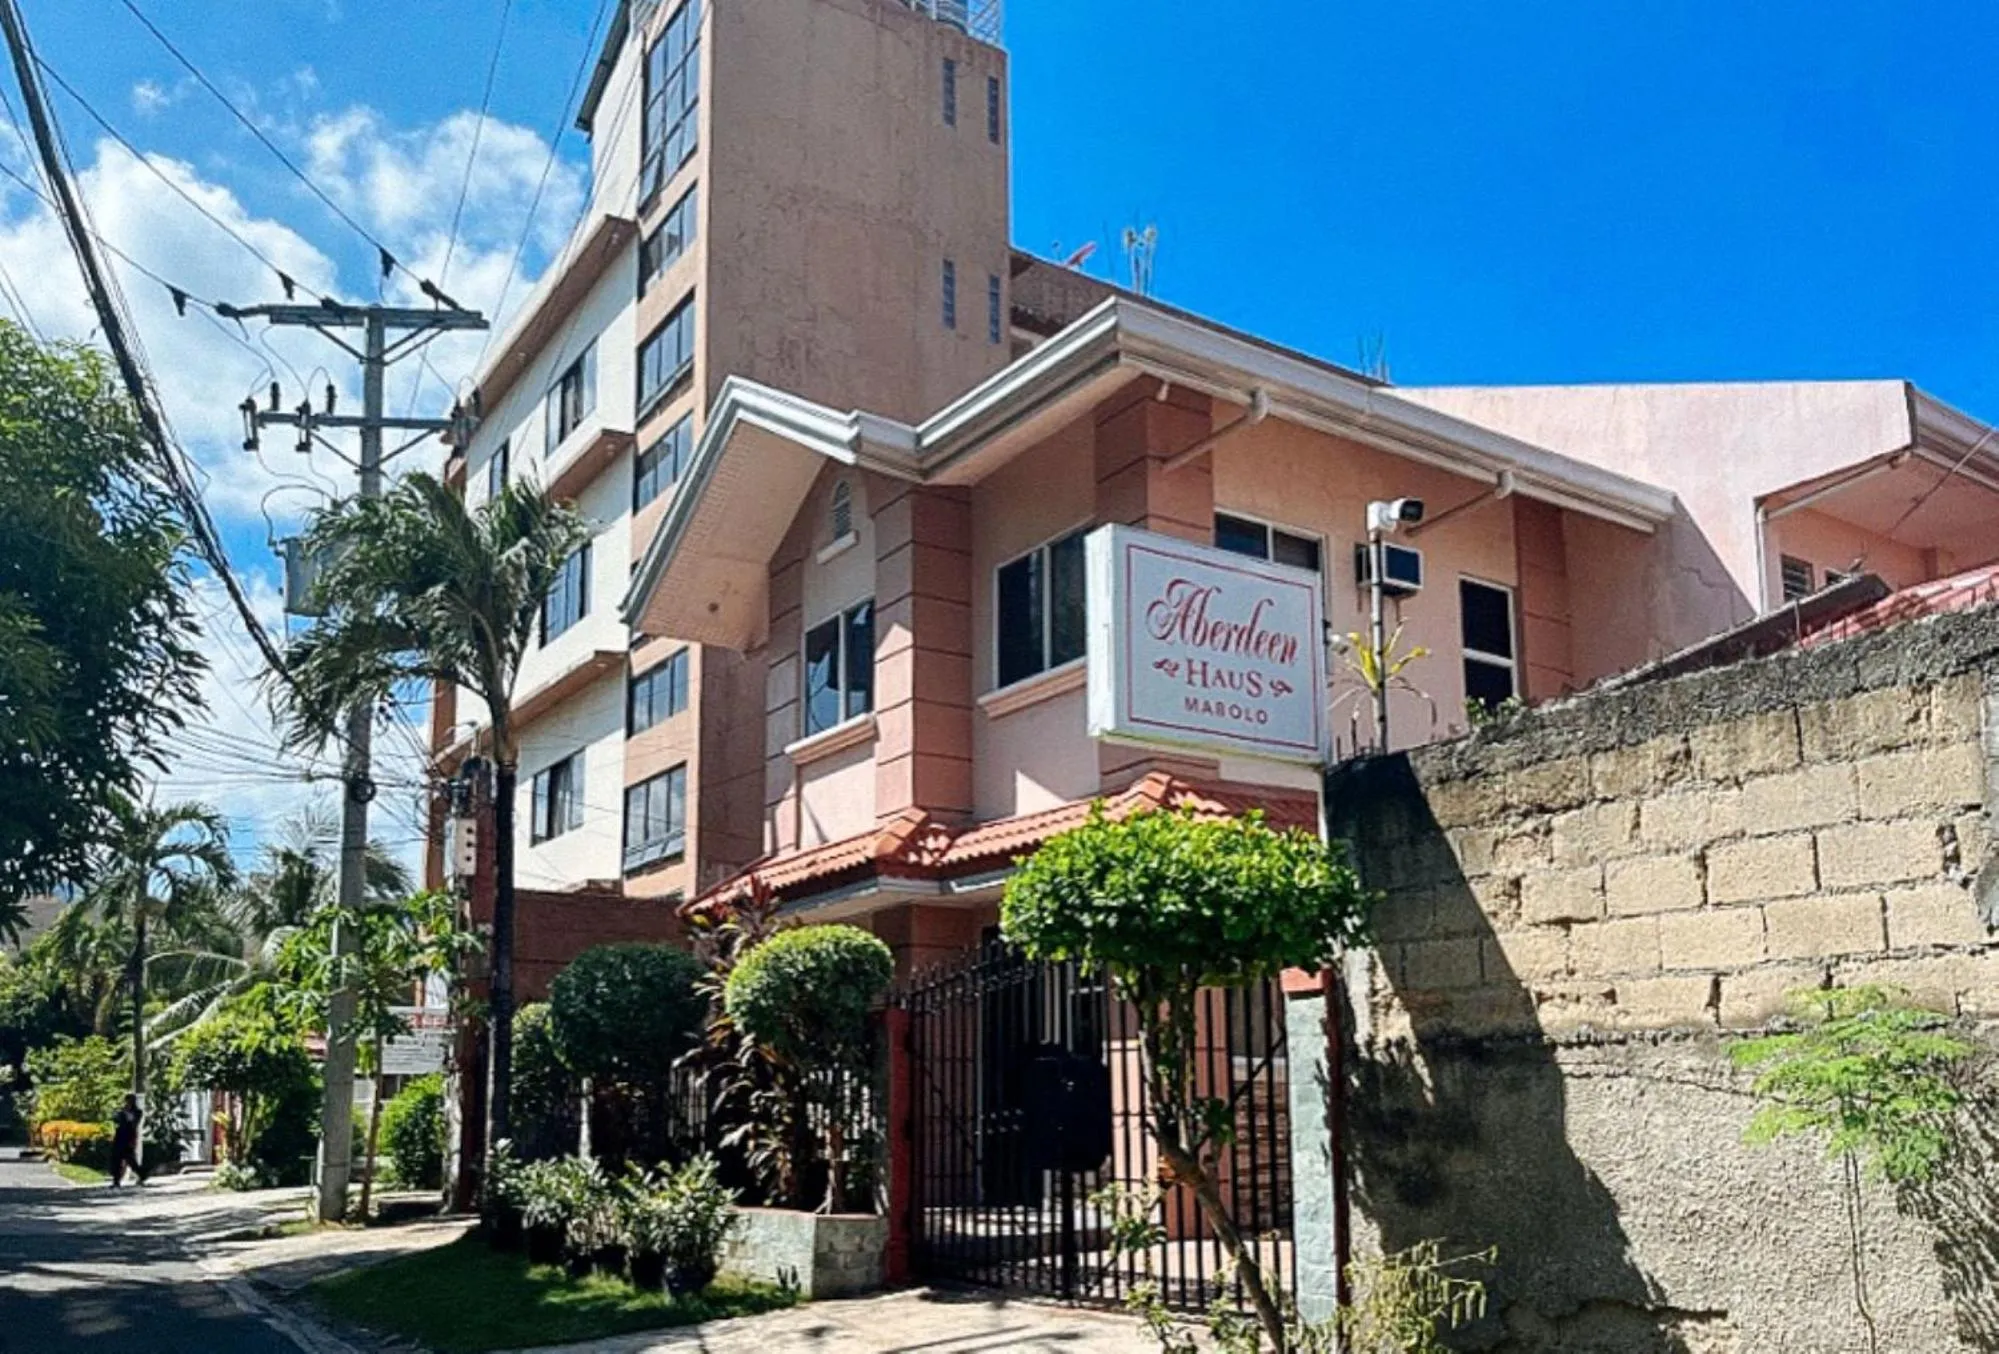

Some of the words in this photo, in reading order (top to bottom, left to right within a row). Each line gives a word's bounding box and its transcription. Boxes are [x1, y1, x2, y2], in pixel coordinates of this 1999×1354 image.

[1147, 579, 1298, 665] Aberdeen
[1186, 658, 1263, 698] HAUS
[1184, 697, 1268, 724] MABOLO
